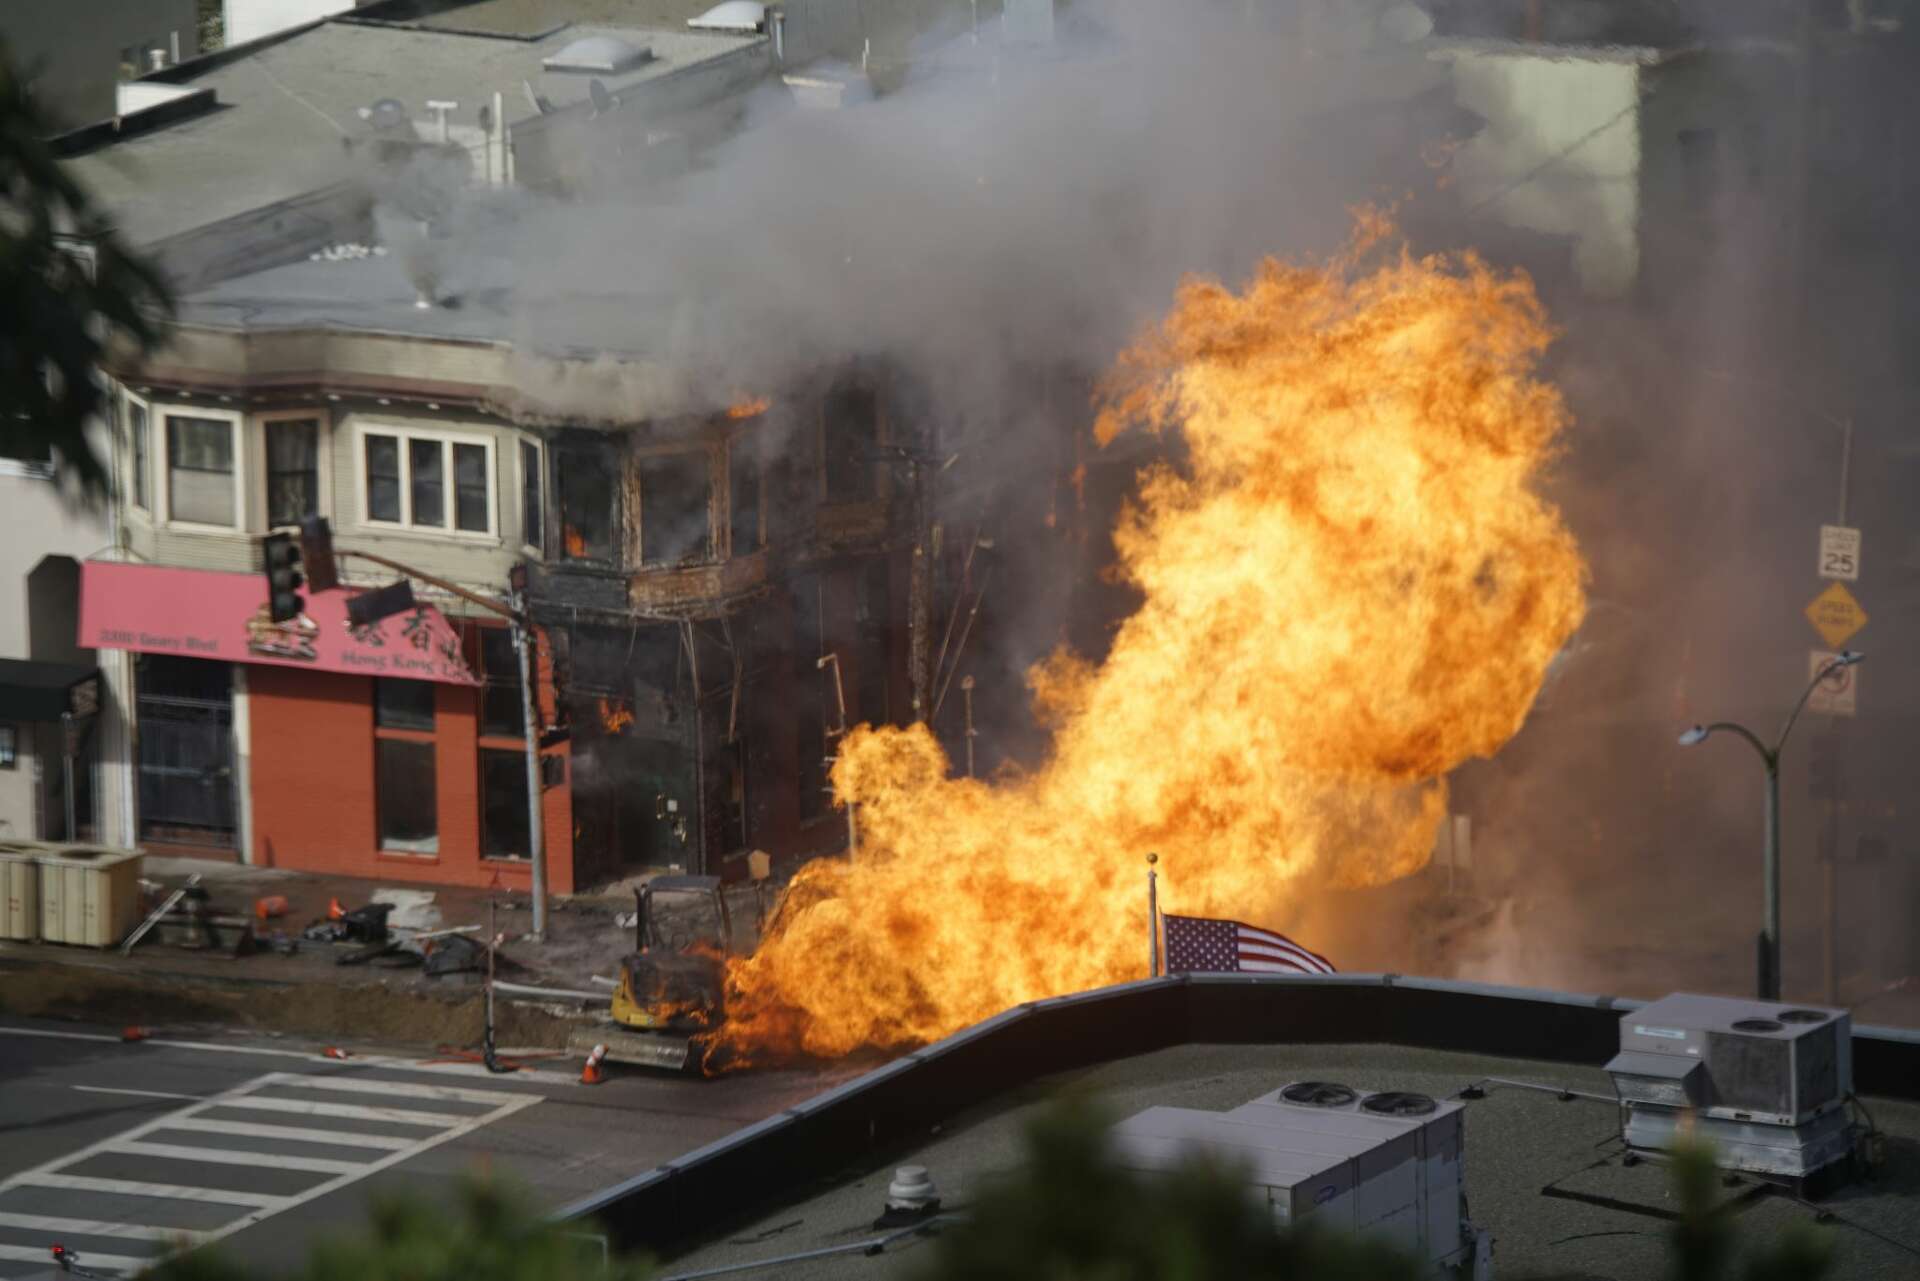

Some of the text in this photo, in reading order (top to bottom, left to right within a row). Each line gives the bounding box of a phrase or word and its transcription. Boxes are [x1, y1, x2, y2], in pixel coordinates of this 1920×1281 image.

[1824, 552, 1854, 574] 25
[139, 632, 180, 650] Geary
[187, 636, 217, 650] Blvd
[342, 651, 386, 669] Hong
[393, 653, 434, 674] Kong
